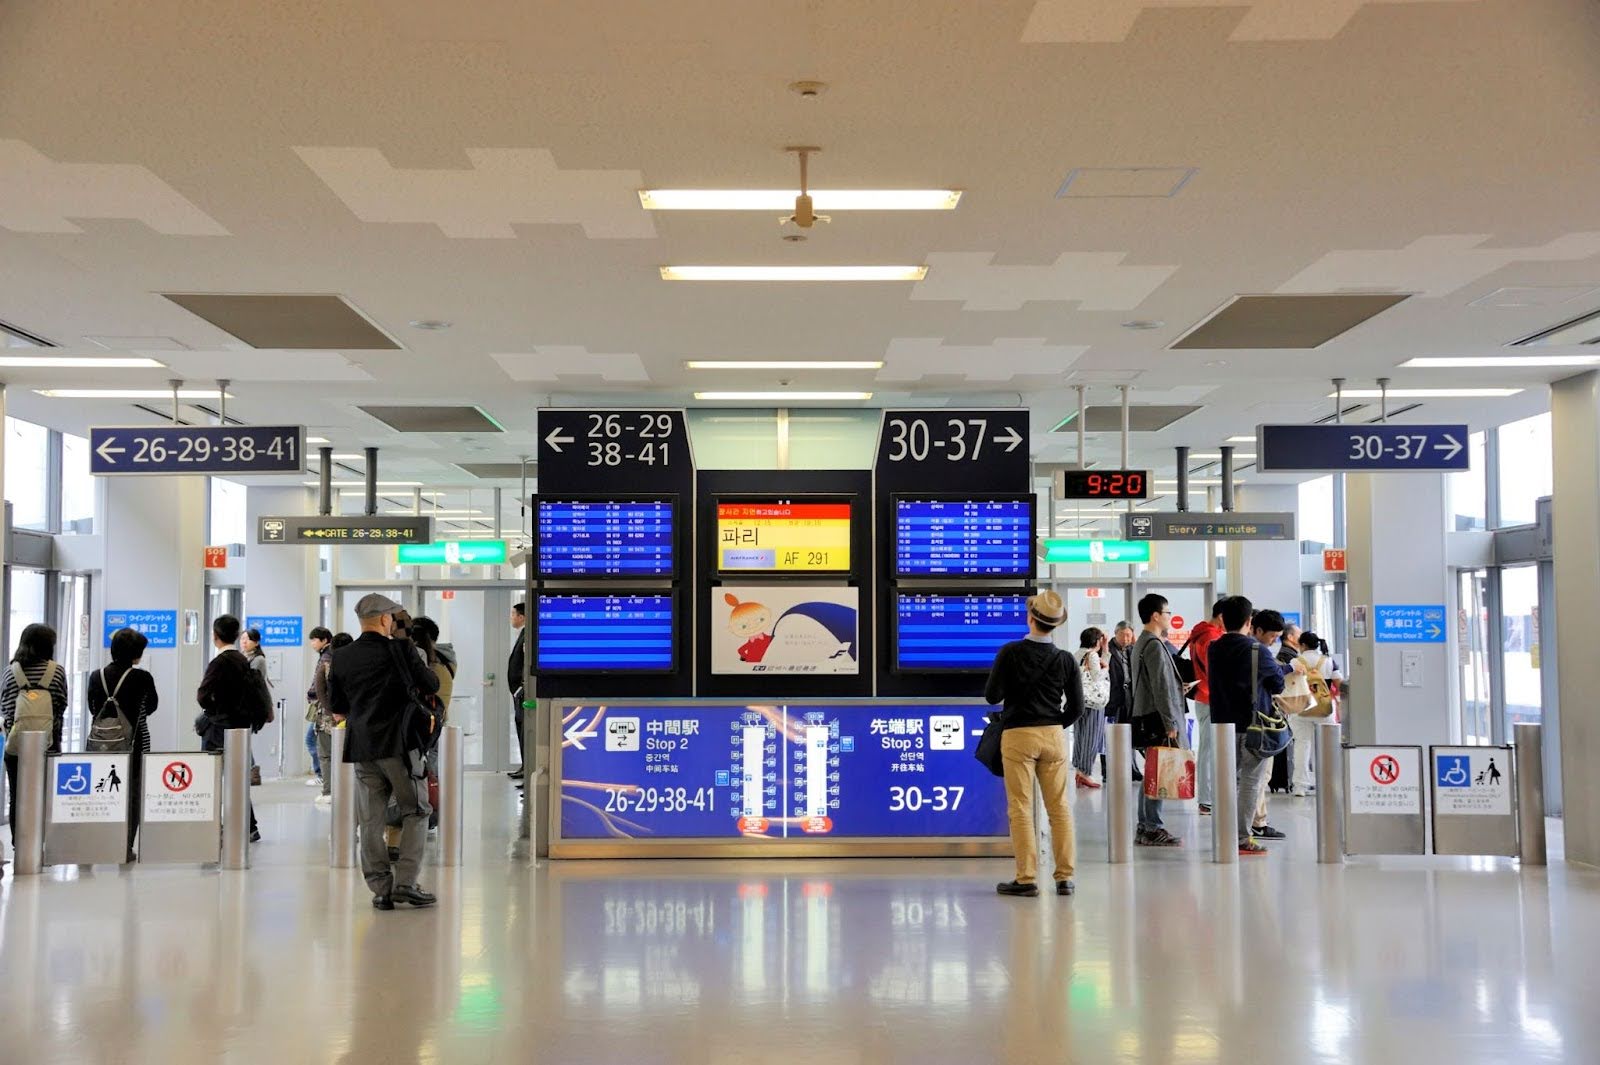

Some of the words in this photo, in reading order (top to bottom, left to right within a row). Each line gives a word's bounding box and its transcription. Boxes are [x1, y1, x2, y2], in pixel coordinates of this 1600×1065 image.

[587, 413, 673, 438] 26-29
[889, 418, 987, 462] 30-37
[1349, 435, 1427, 460] 30-37
[587, 442, 671, 467] 38-41
[1088, 475, 1142, 495] 9:20
[325, 529, 348, 538] GATE
[722, 527, 758, 546] 파리
[1168, 525, 1197, 536] Every
[1206, 525, 1213, 534] 2
[1217, 525, 1257, 534] minutes
[784, 552, 800, 565] AF
[808, 552, 829, 565] 291
[128, 614, 173, 622] ウイングシャトル
[1415, 619, 1423, 628] 2
[160, 624, 169, 633] 2
[646, 719, 700, 736] 中間駅
[870, 718, 924, 735] 先端駅
[646, 738, 676, 752] Stop
[680, 738, 689, 749] 2
[881, 737, 911, 751] Stop
[915, 737, 923, 749] 3
[889, 786, 965, 811] 30-37
